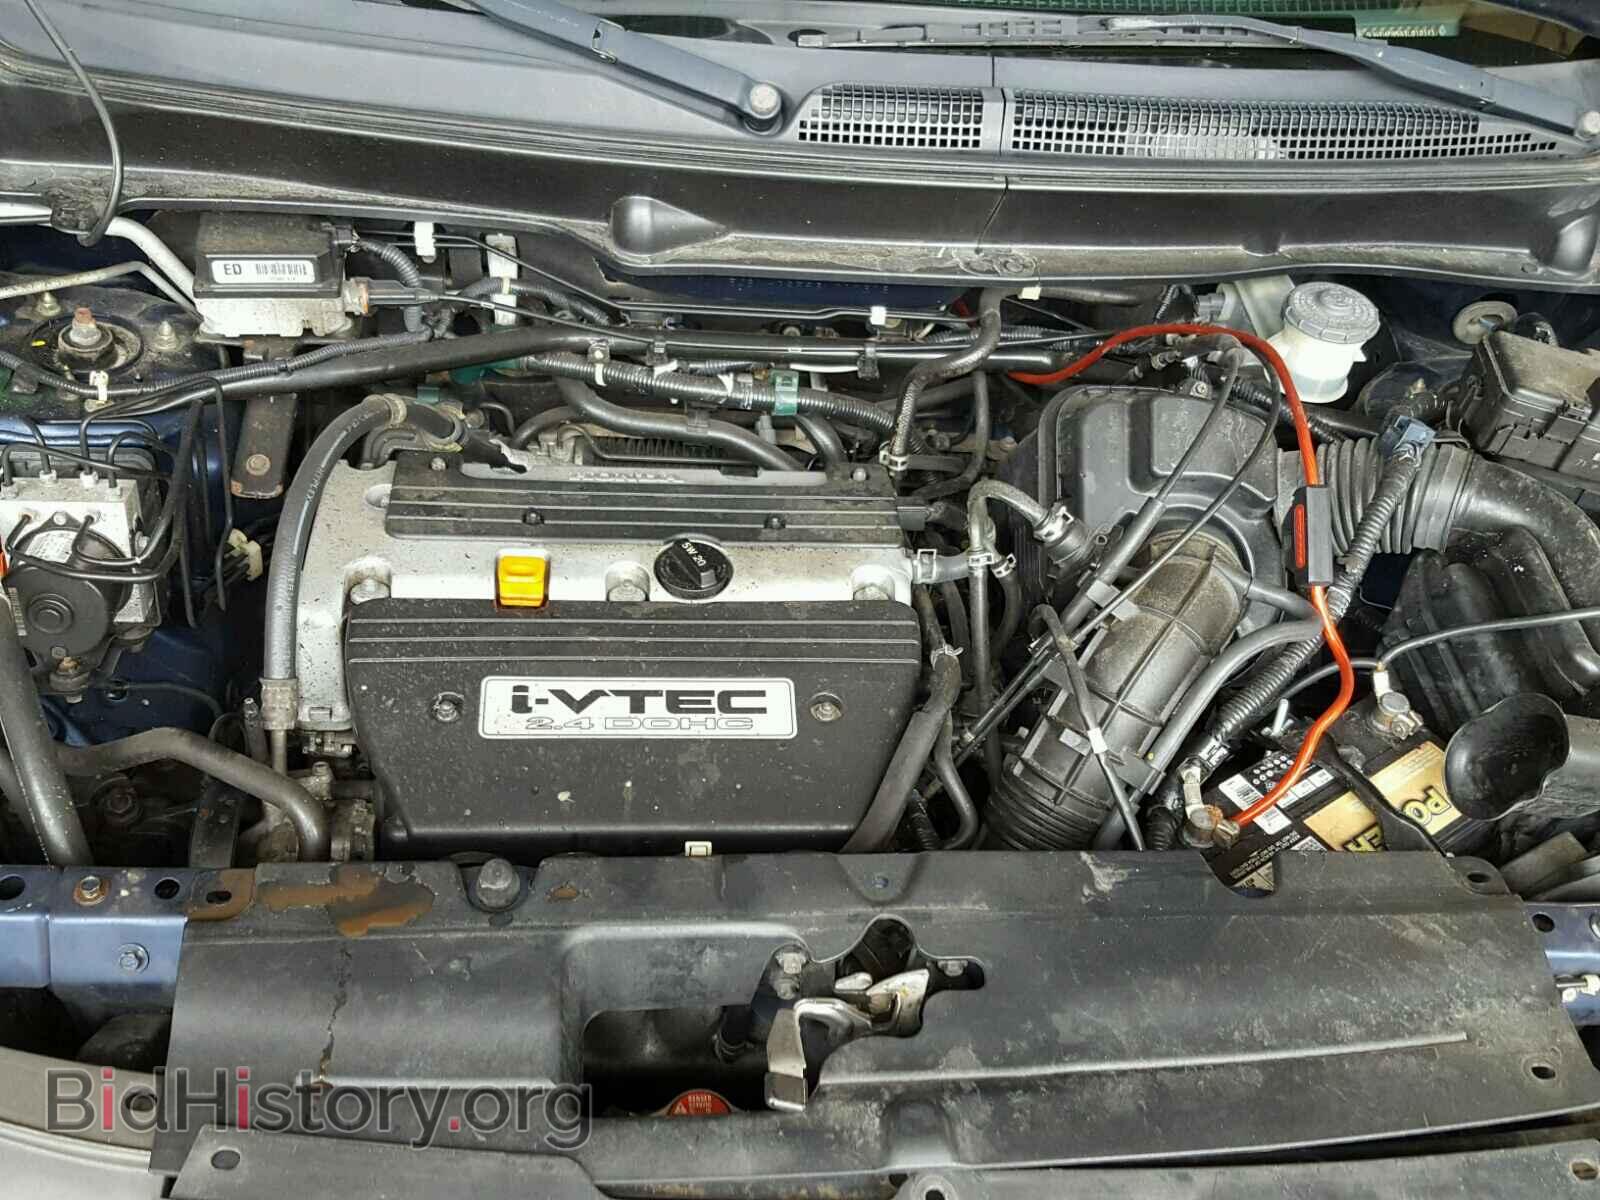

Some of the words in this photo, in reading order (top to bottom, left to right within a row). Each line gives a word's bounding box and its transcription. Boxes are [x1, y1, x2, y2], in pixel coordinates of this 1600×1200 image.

[511, 685, 767, 714] i-VTEC
[525, 717, 595, 730] 2.4
[604, 717, 754, 730] DOHC
